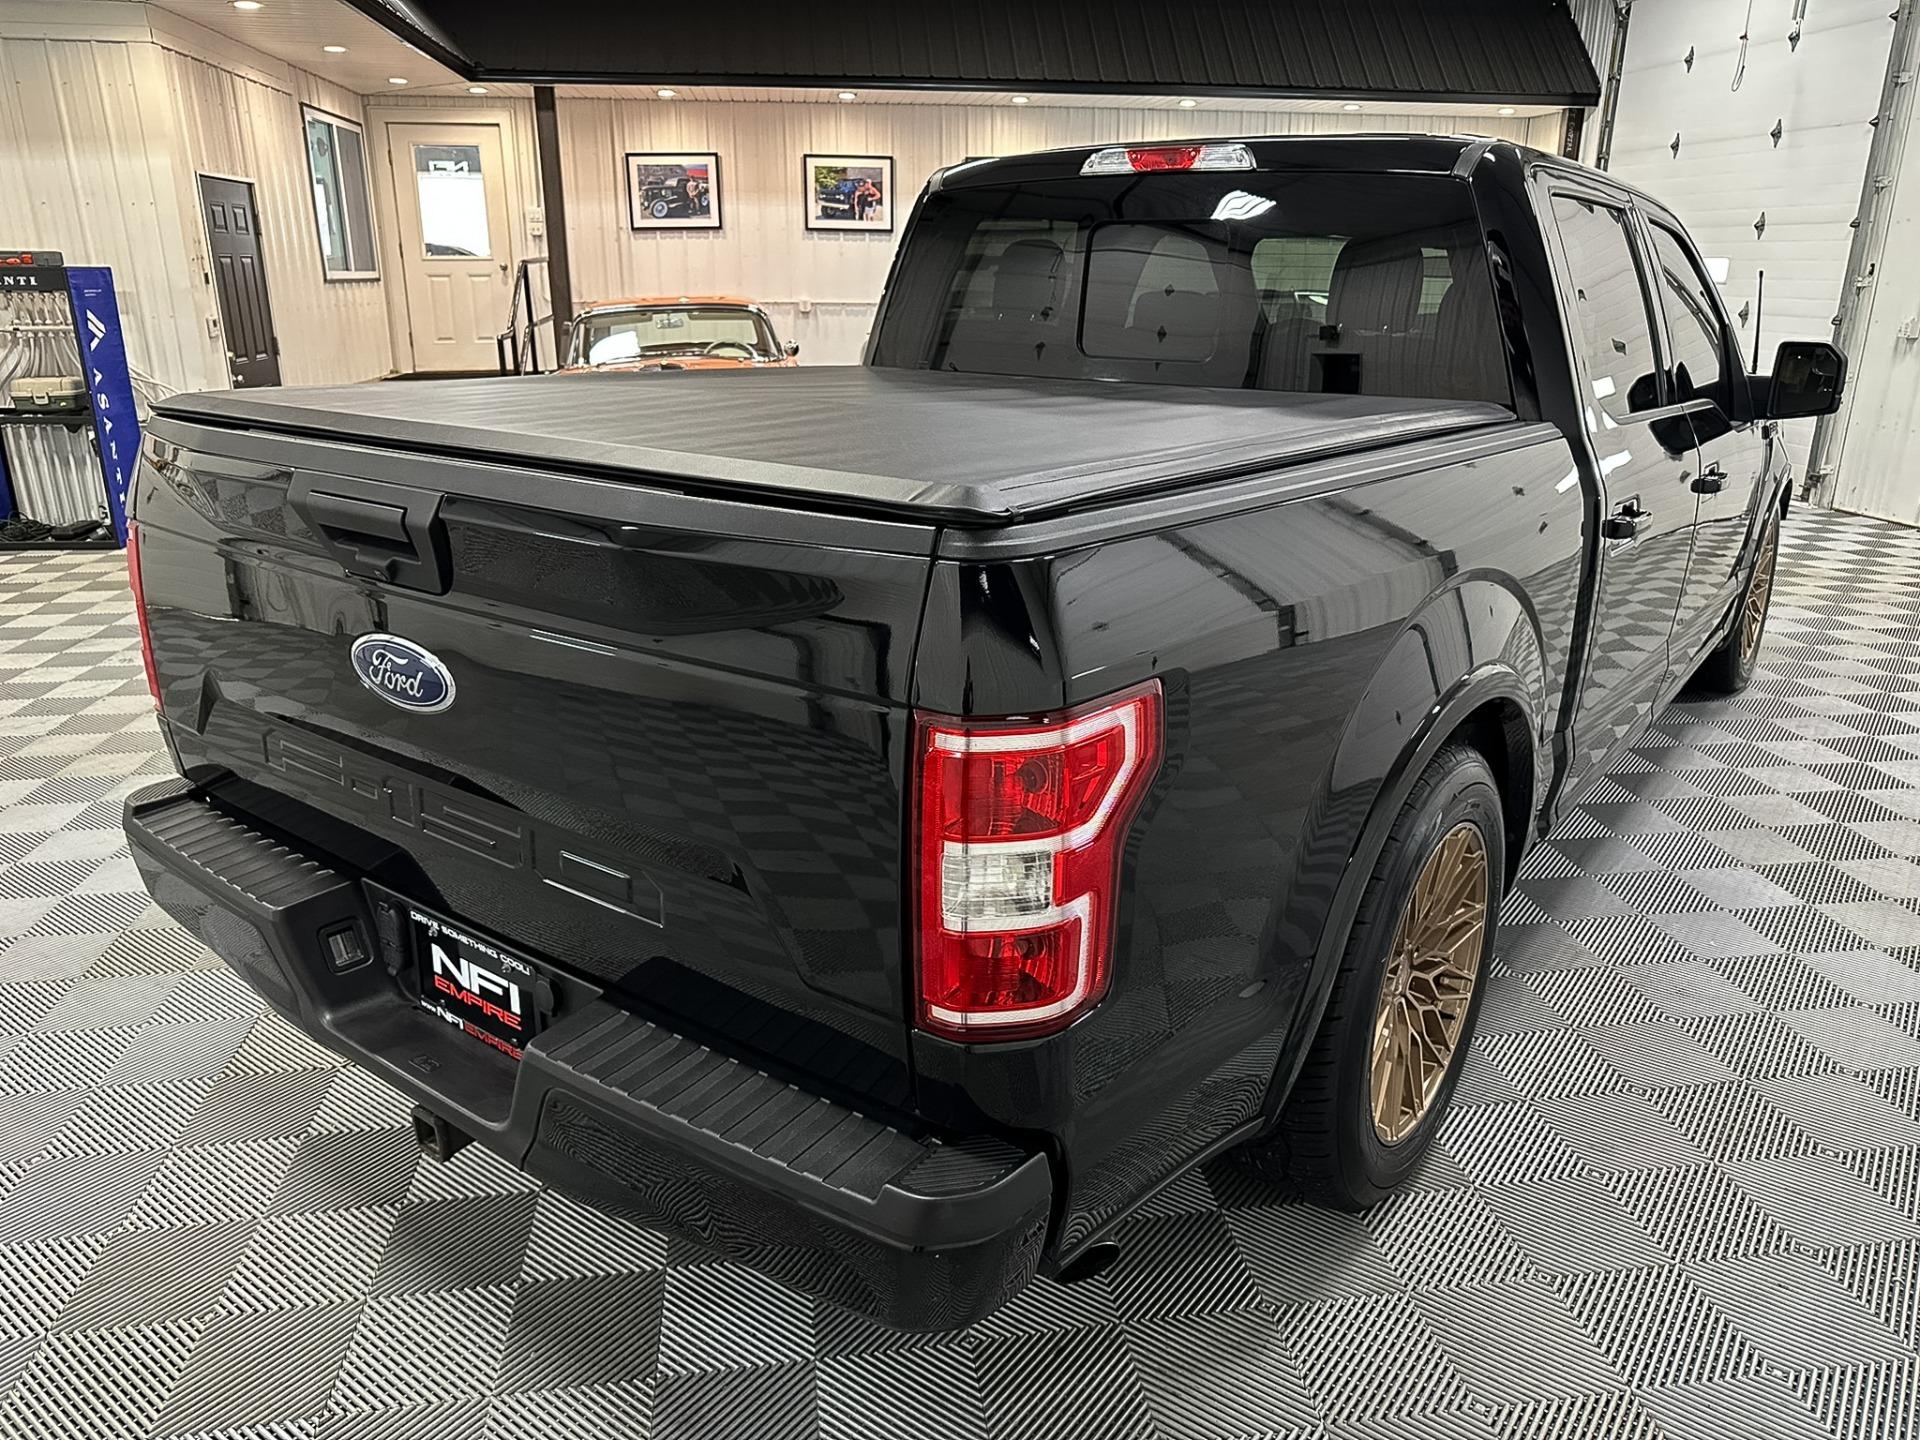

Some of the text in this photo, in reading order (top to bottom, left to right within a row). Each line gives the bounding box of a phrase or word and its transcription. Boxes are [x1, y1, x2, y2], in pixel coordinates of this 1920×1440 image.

[0, 276, 38, 286] NTI
[93, 367, 126, 505] ASANTI
[369, 649, 424, 698] Ford
[410, 910, 440, 931] DRIVE
[441, 925, 498, 959] SOMETHING
[431, 942, 521, 1016] NFI
[434, 974, 522, 1031] EMPIRE
